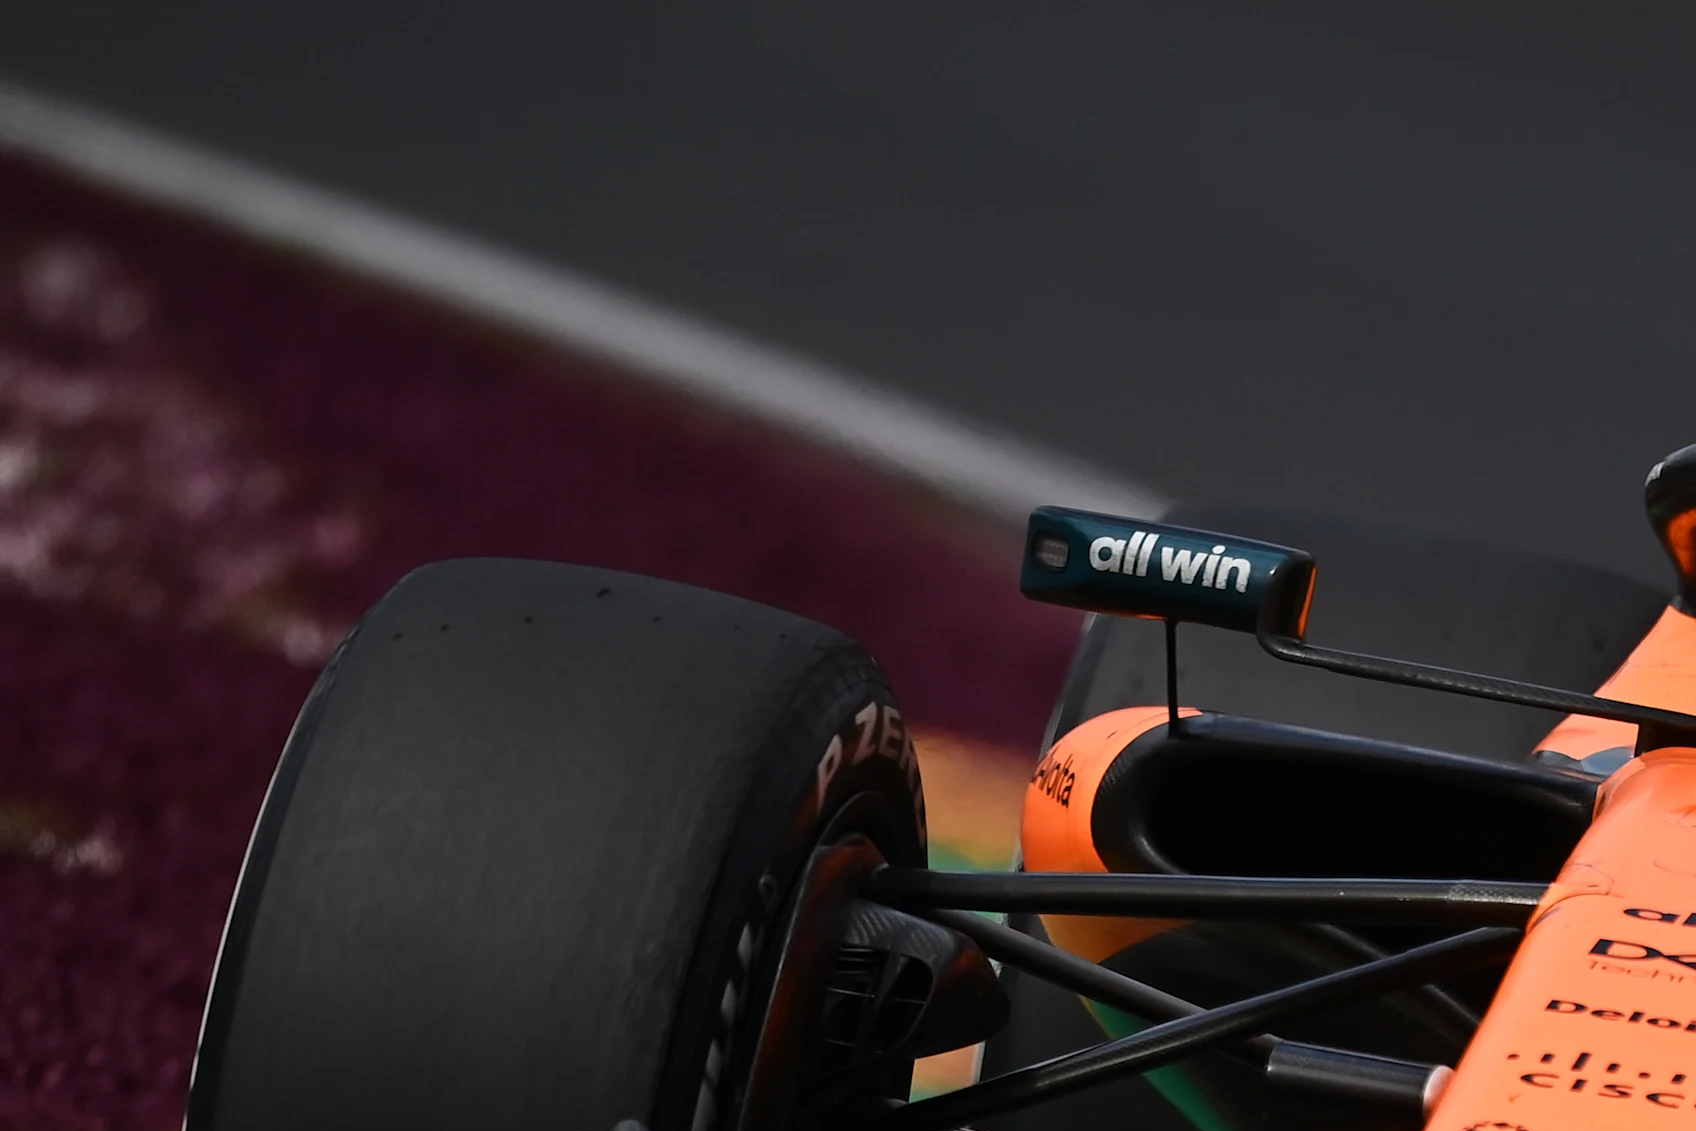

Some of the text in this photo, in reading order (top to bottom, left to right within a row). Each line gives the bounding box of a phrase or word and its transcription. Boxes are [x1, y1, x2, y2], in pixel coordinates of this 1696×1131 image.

[1089, 530, 1252, 594] all win
[816, 734, 843, 818] P
